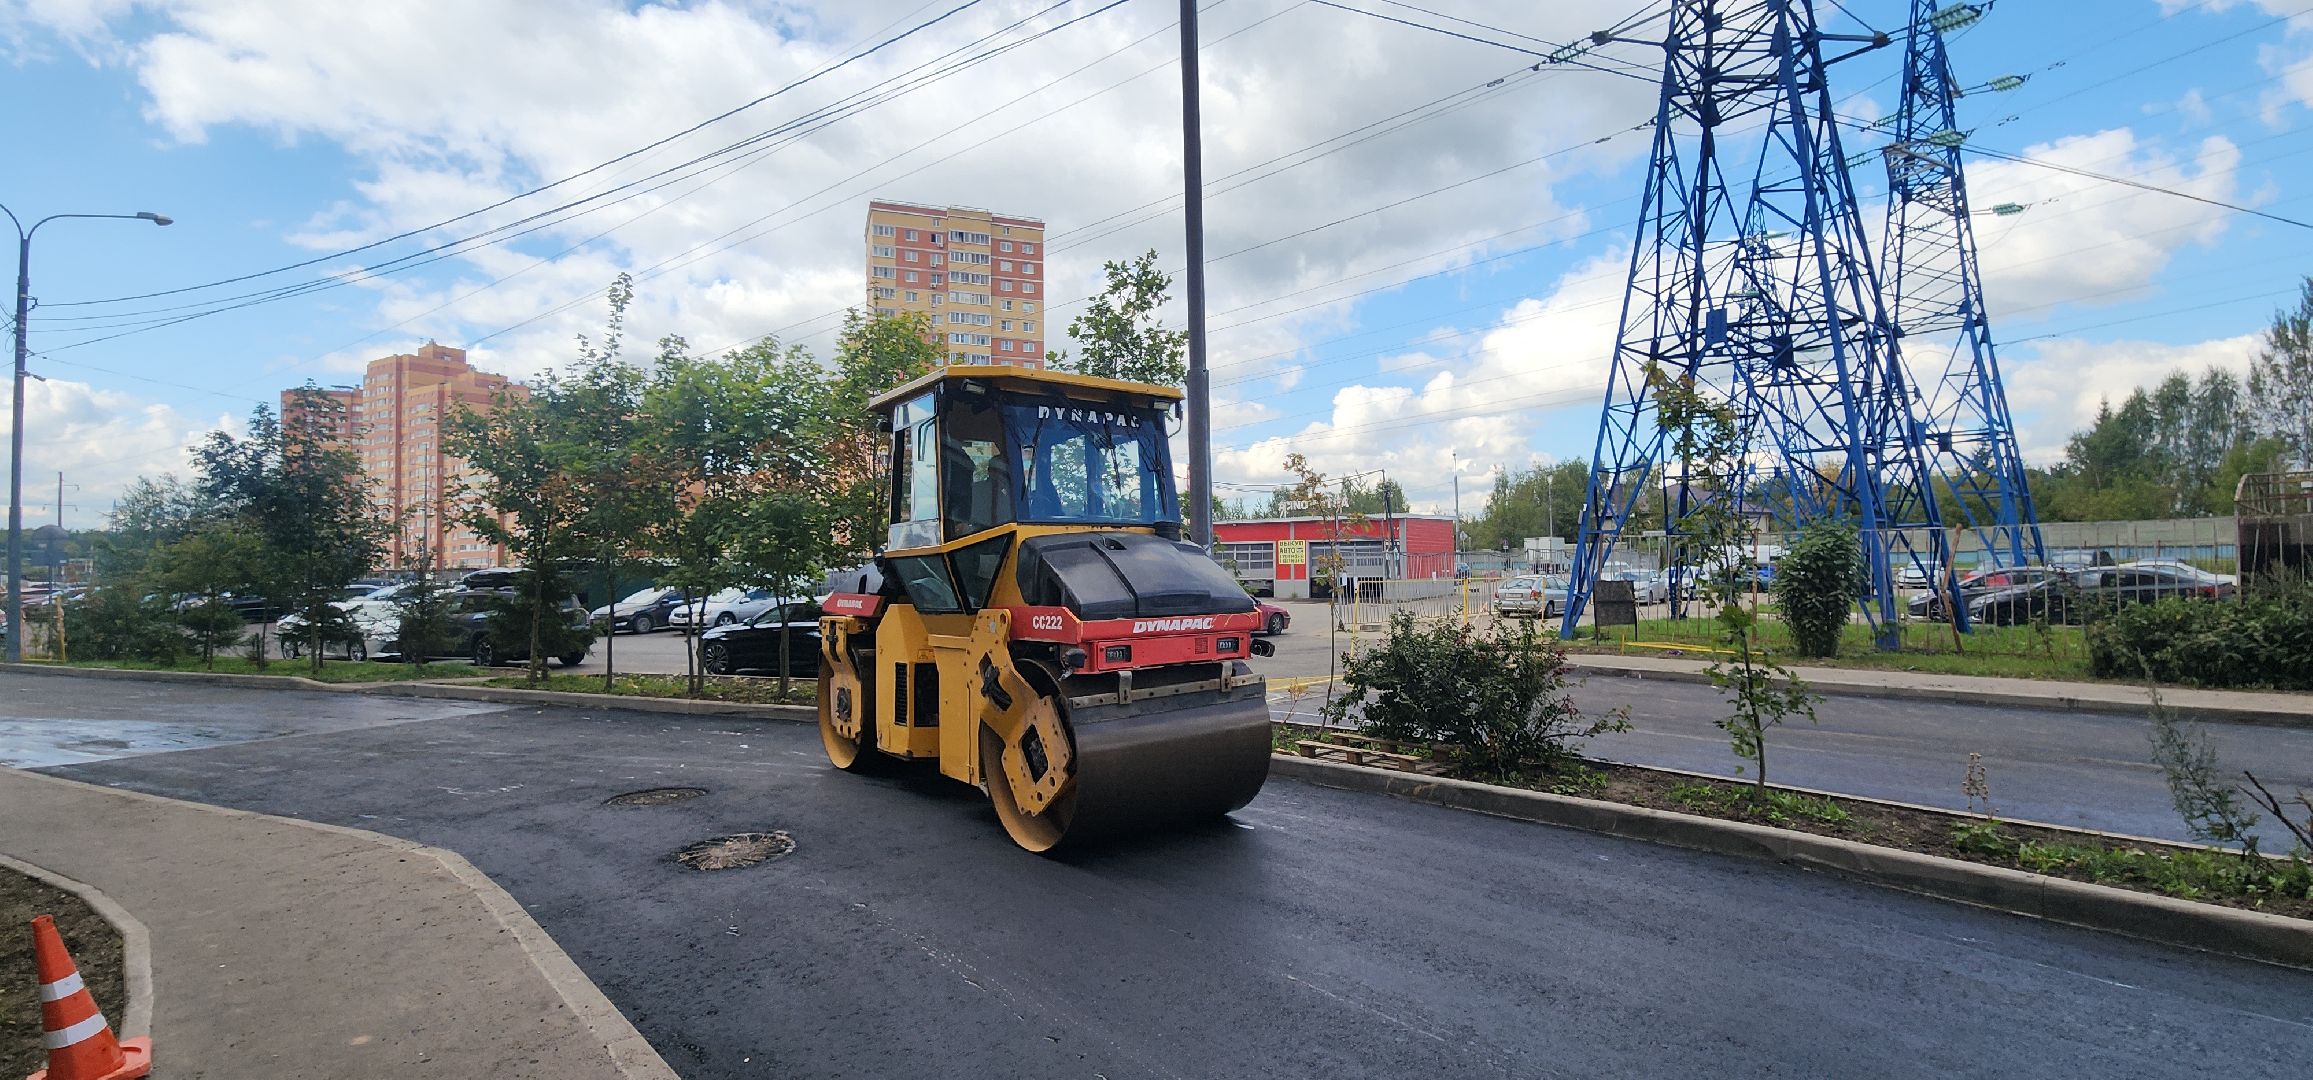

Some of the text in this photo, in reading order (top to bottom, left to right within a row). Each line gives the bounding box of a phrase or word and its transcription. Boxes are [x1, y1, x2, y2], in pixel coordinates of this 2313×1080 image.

[1038, 404, 1140, 428] DYNAPAC
[1032, 615, 1063, 630] CC222
[1132, 617, 1213, 634] DYNAPAC
